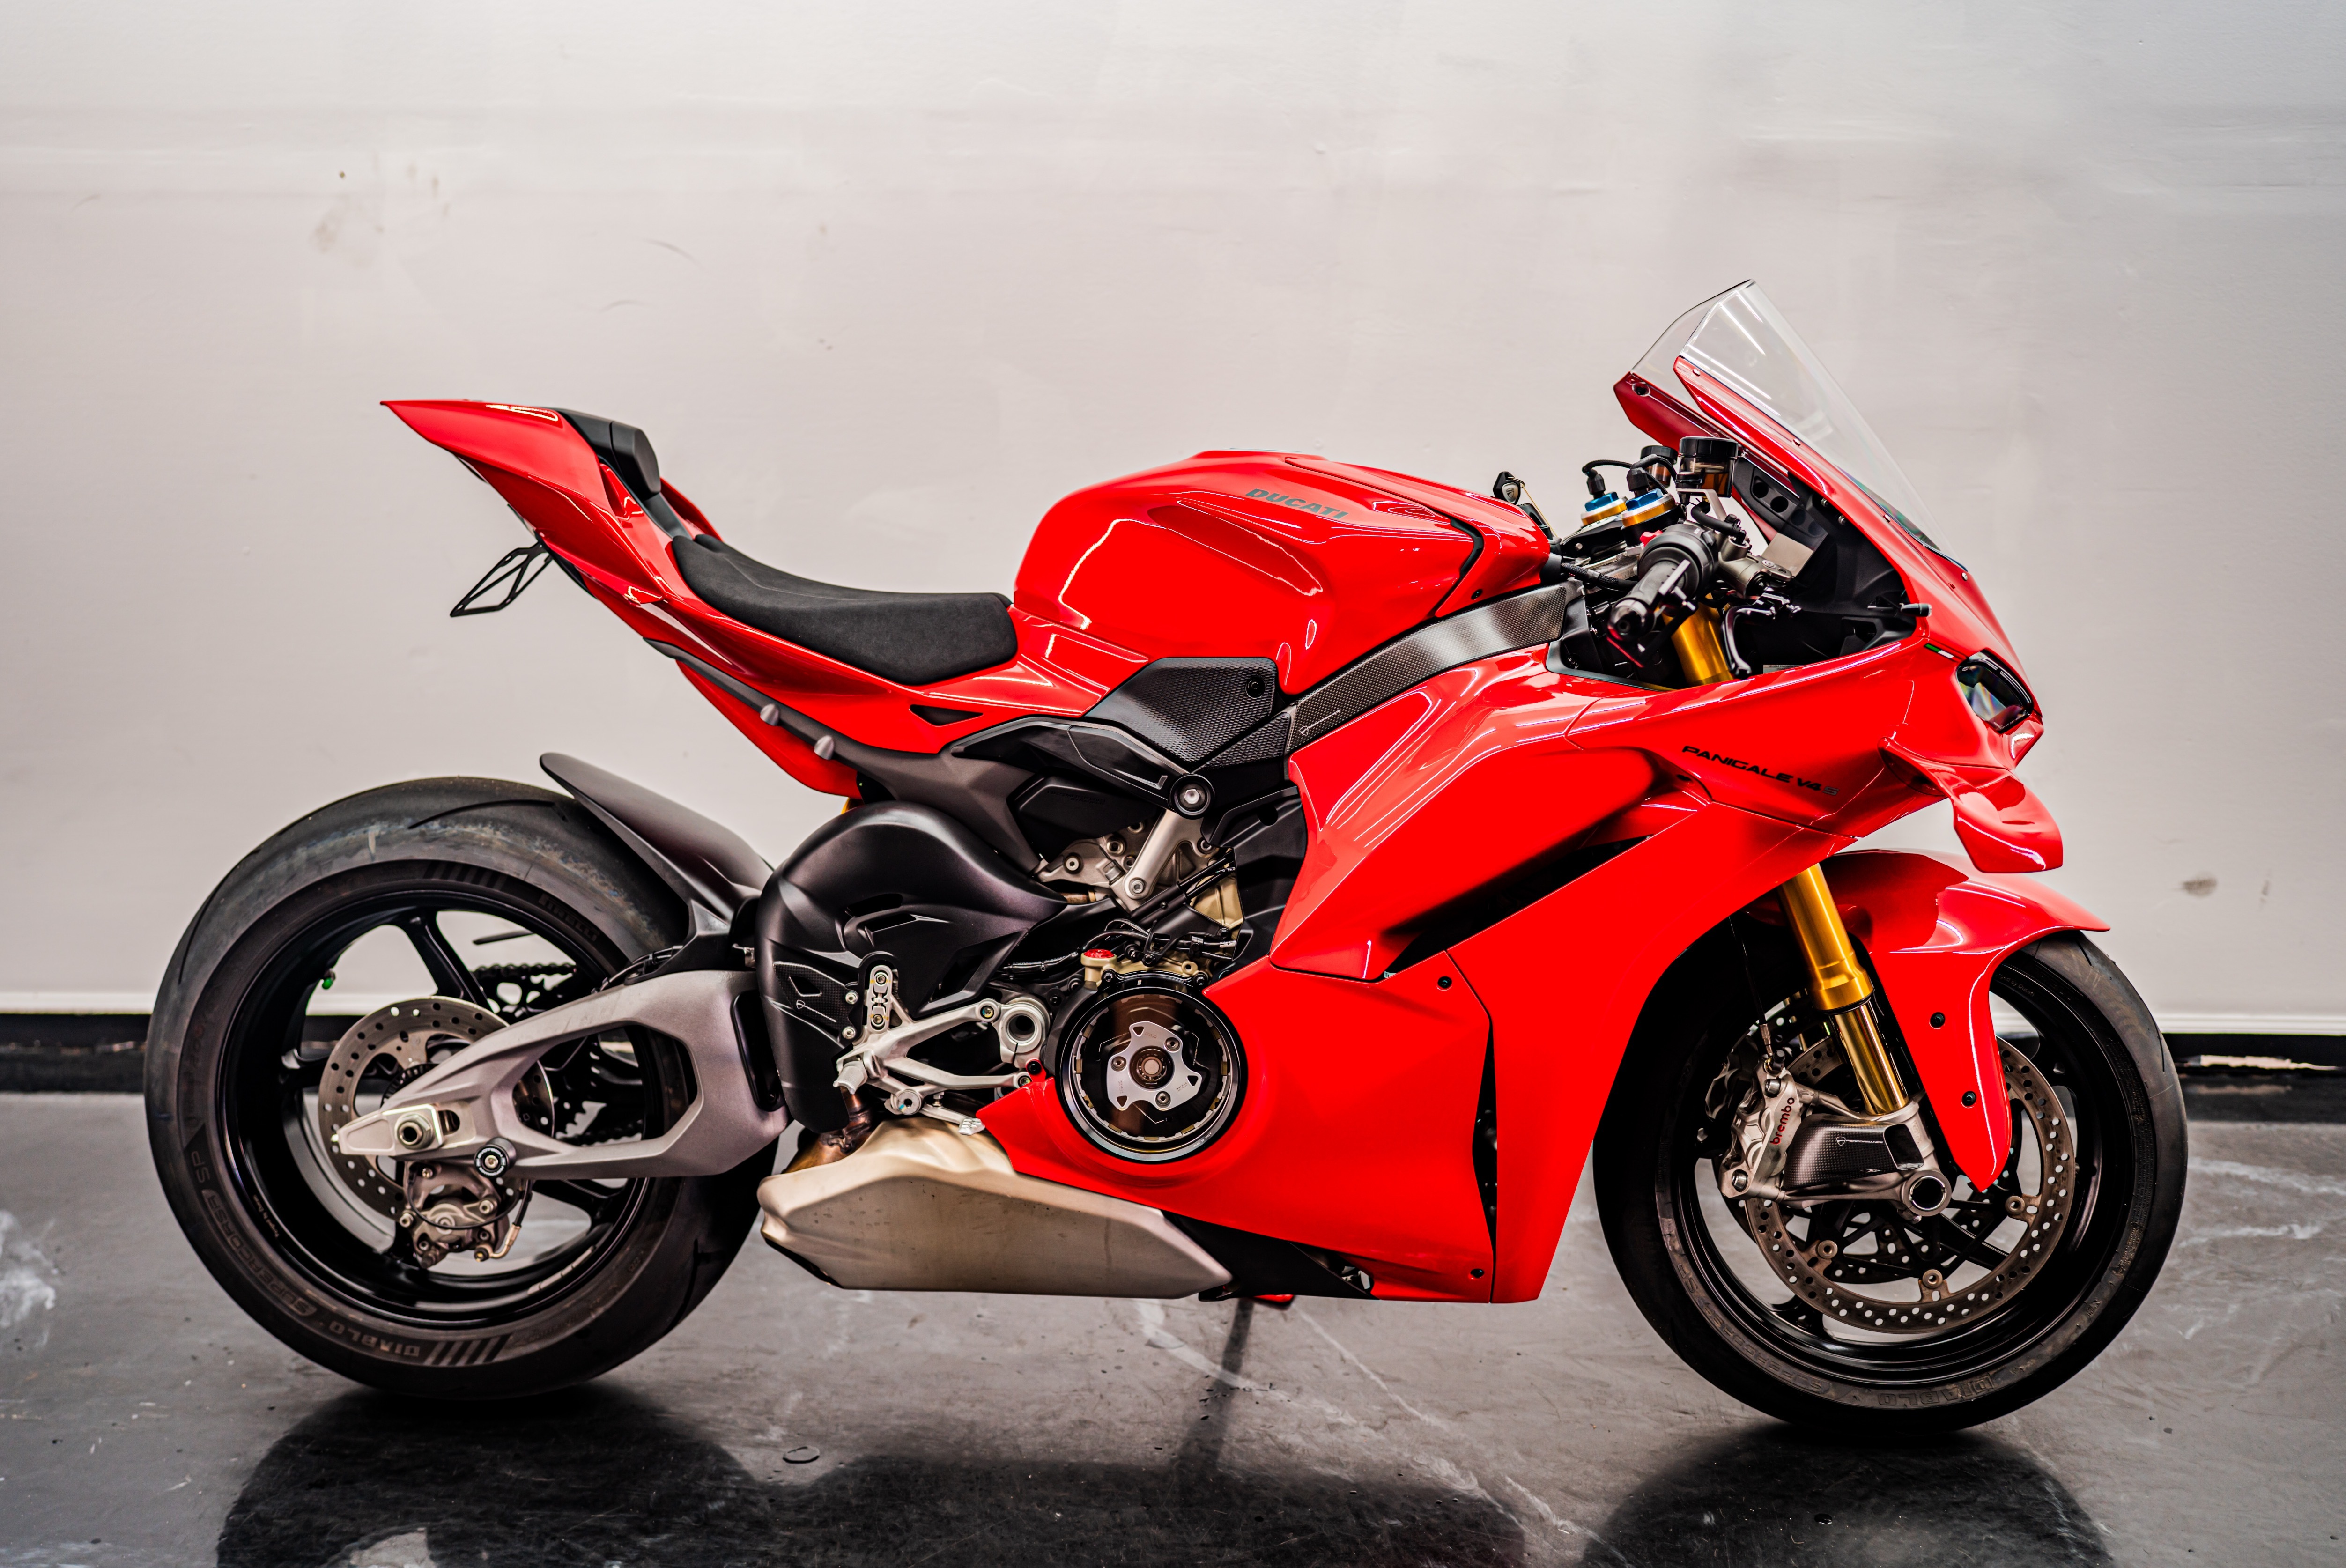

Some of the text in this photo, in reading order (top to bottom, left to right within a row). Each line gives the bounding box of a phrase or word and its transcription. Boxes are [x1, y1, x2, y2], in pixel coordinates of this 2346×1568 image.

[1245, 488, 1349, 519] DUCATI
[1682, 746, 1793, 783] PANIGALE
[539, 893, 600, 942] PIRELLI
[1770, 1097, 1795, 1145] brembo
[192, 1150, 419, 1357] DIABLO SUPERCORSA SP
[1676, 1262, 1993, 1406] DIABLO SUPERCORSA SP
